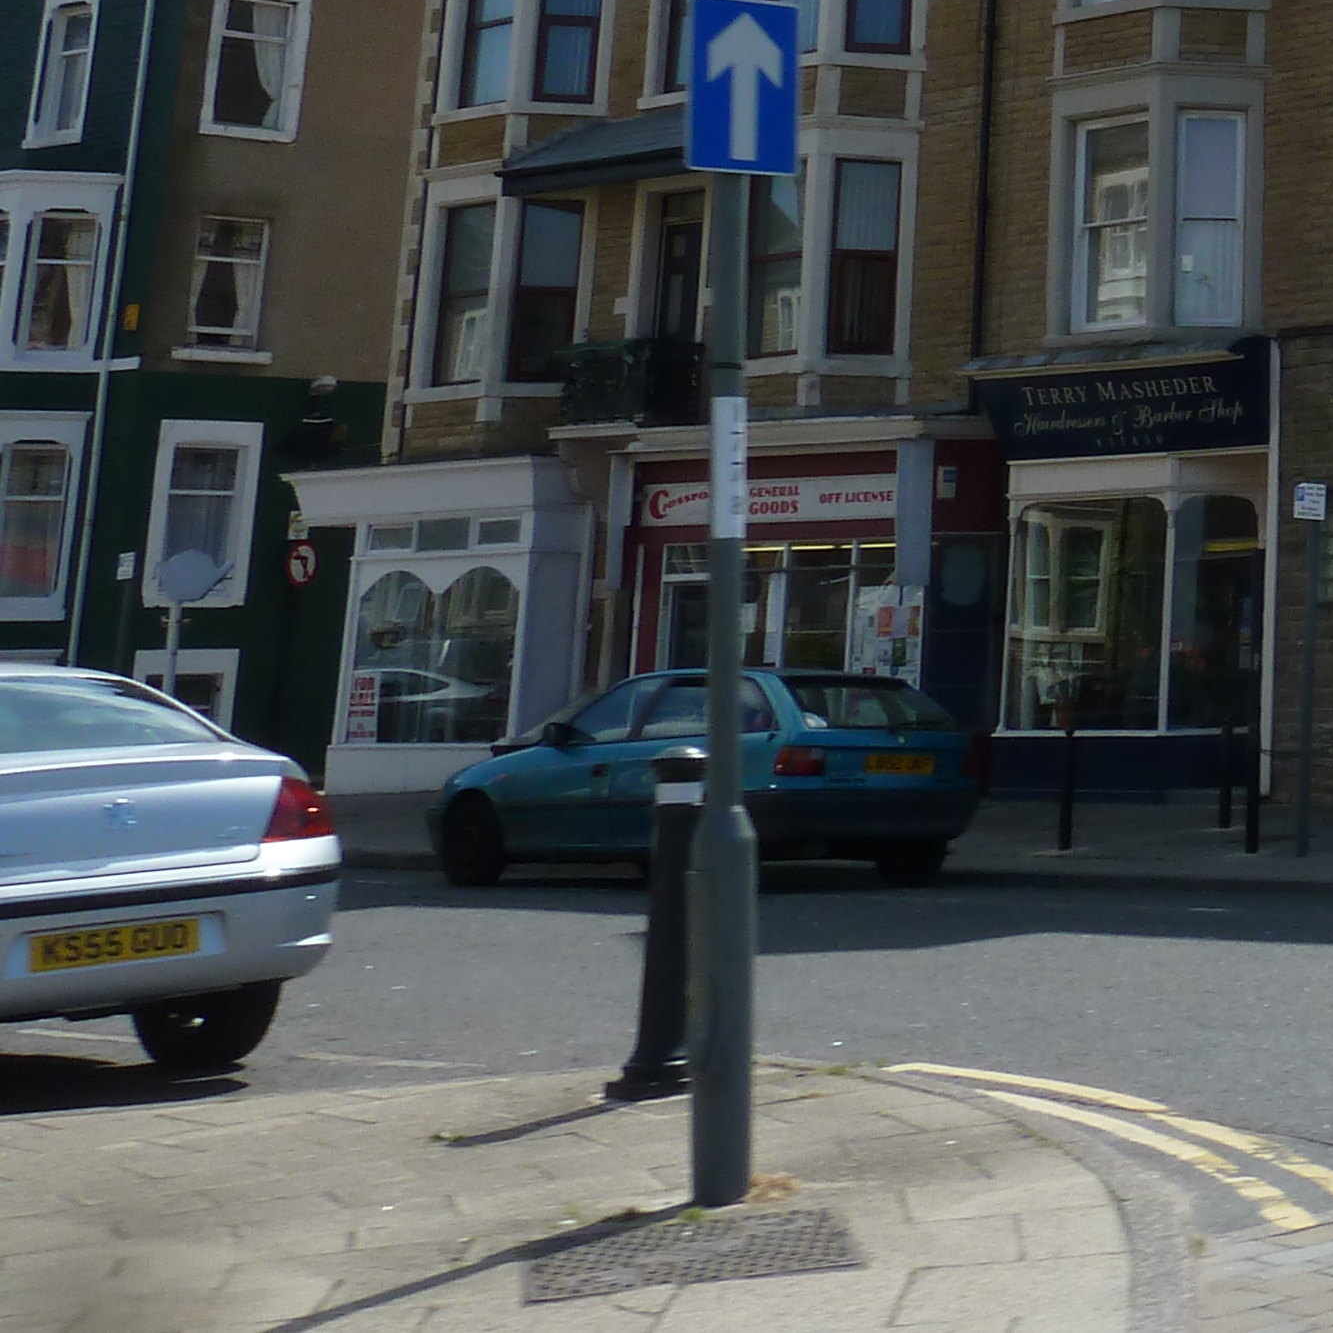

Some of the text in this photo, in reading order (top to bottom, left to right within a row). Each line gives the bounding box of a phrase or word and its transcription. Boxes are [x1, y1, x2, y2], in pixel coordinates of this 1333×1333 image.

[1021, 375, 1218, 406] TERRY MASHEDER
[749, 485, 800, 499] GENERAL
[818, 493, 842, 504] OFF
[749, 500, 799, 516] GOODS
